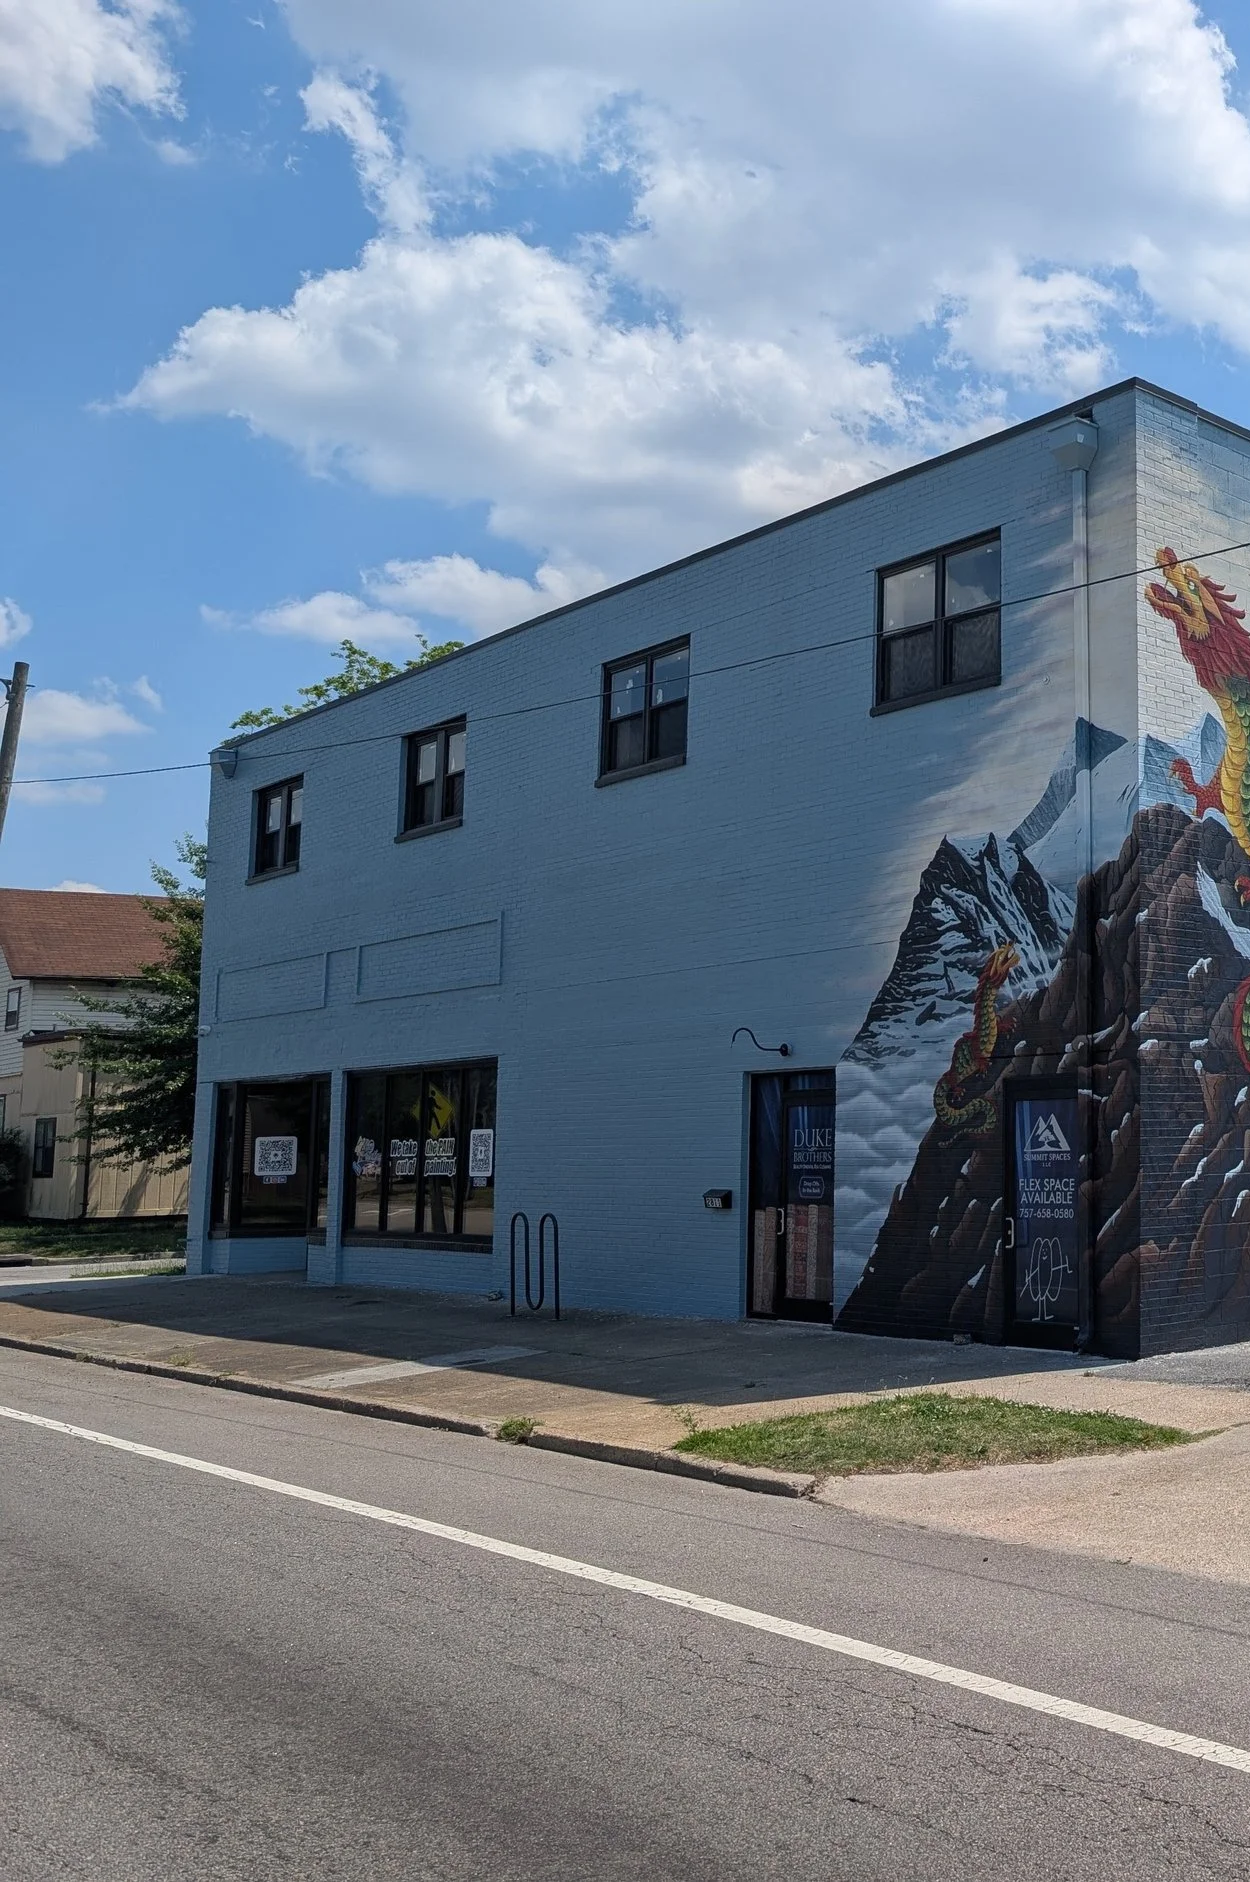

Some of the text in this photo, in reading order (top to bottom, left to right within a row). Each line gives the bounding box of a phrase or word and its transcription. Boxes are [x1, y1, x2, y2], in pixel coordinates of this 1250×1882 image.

[794, 1128, 832, 1147] DUKE
[390, 1139, 402, 1157] We
[402, 1138, 418, 1156] take
[425, 1138, 438, 1156] the
[793, 1151, 832, 1163] BROTHERS
[1023, 1153, 1071, 1161] SUMMIT SPACES
[396, 1157, 457, 1177] out of painting!
[1019, 1178, 1075, 1191] FLEX SPACE
[1020, 1192, 1073, 1204] AVAILABLE
[1019, 1208, 1074, 1219] 757-658-0580
